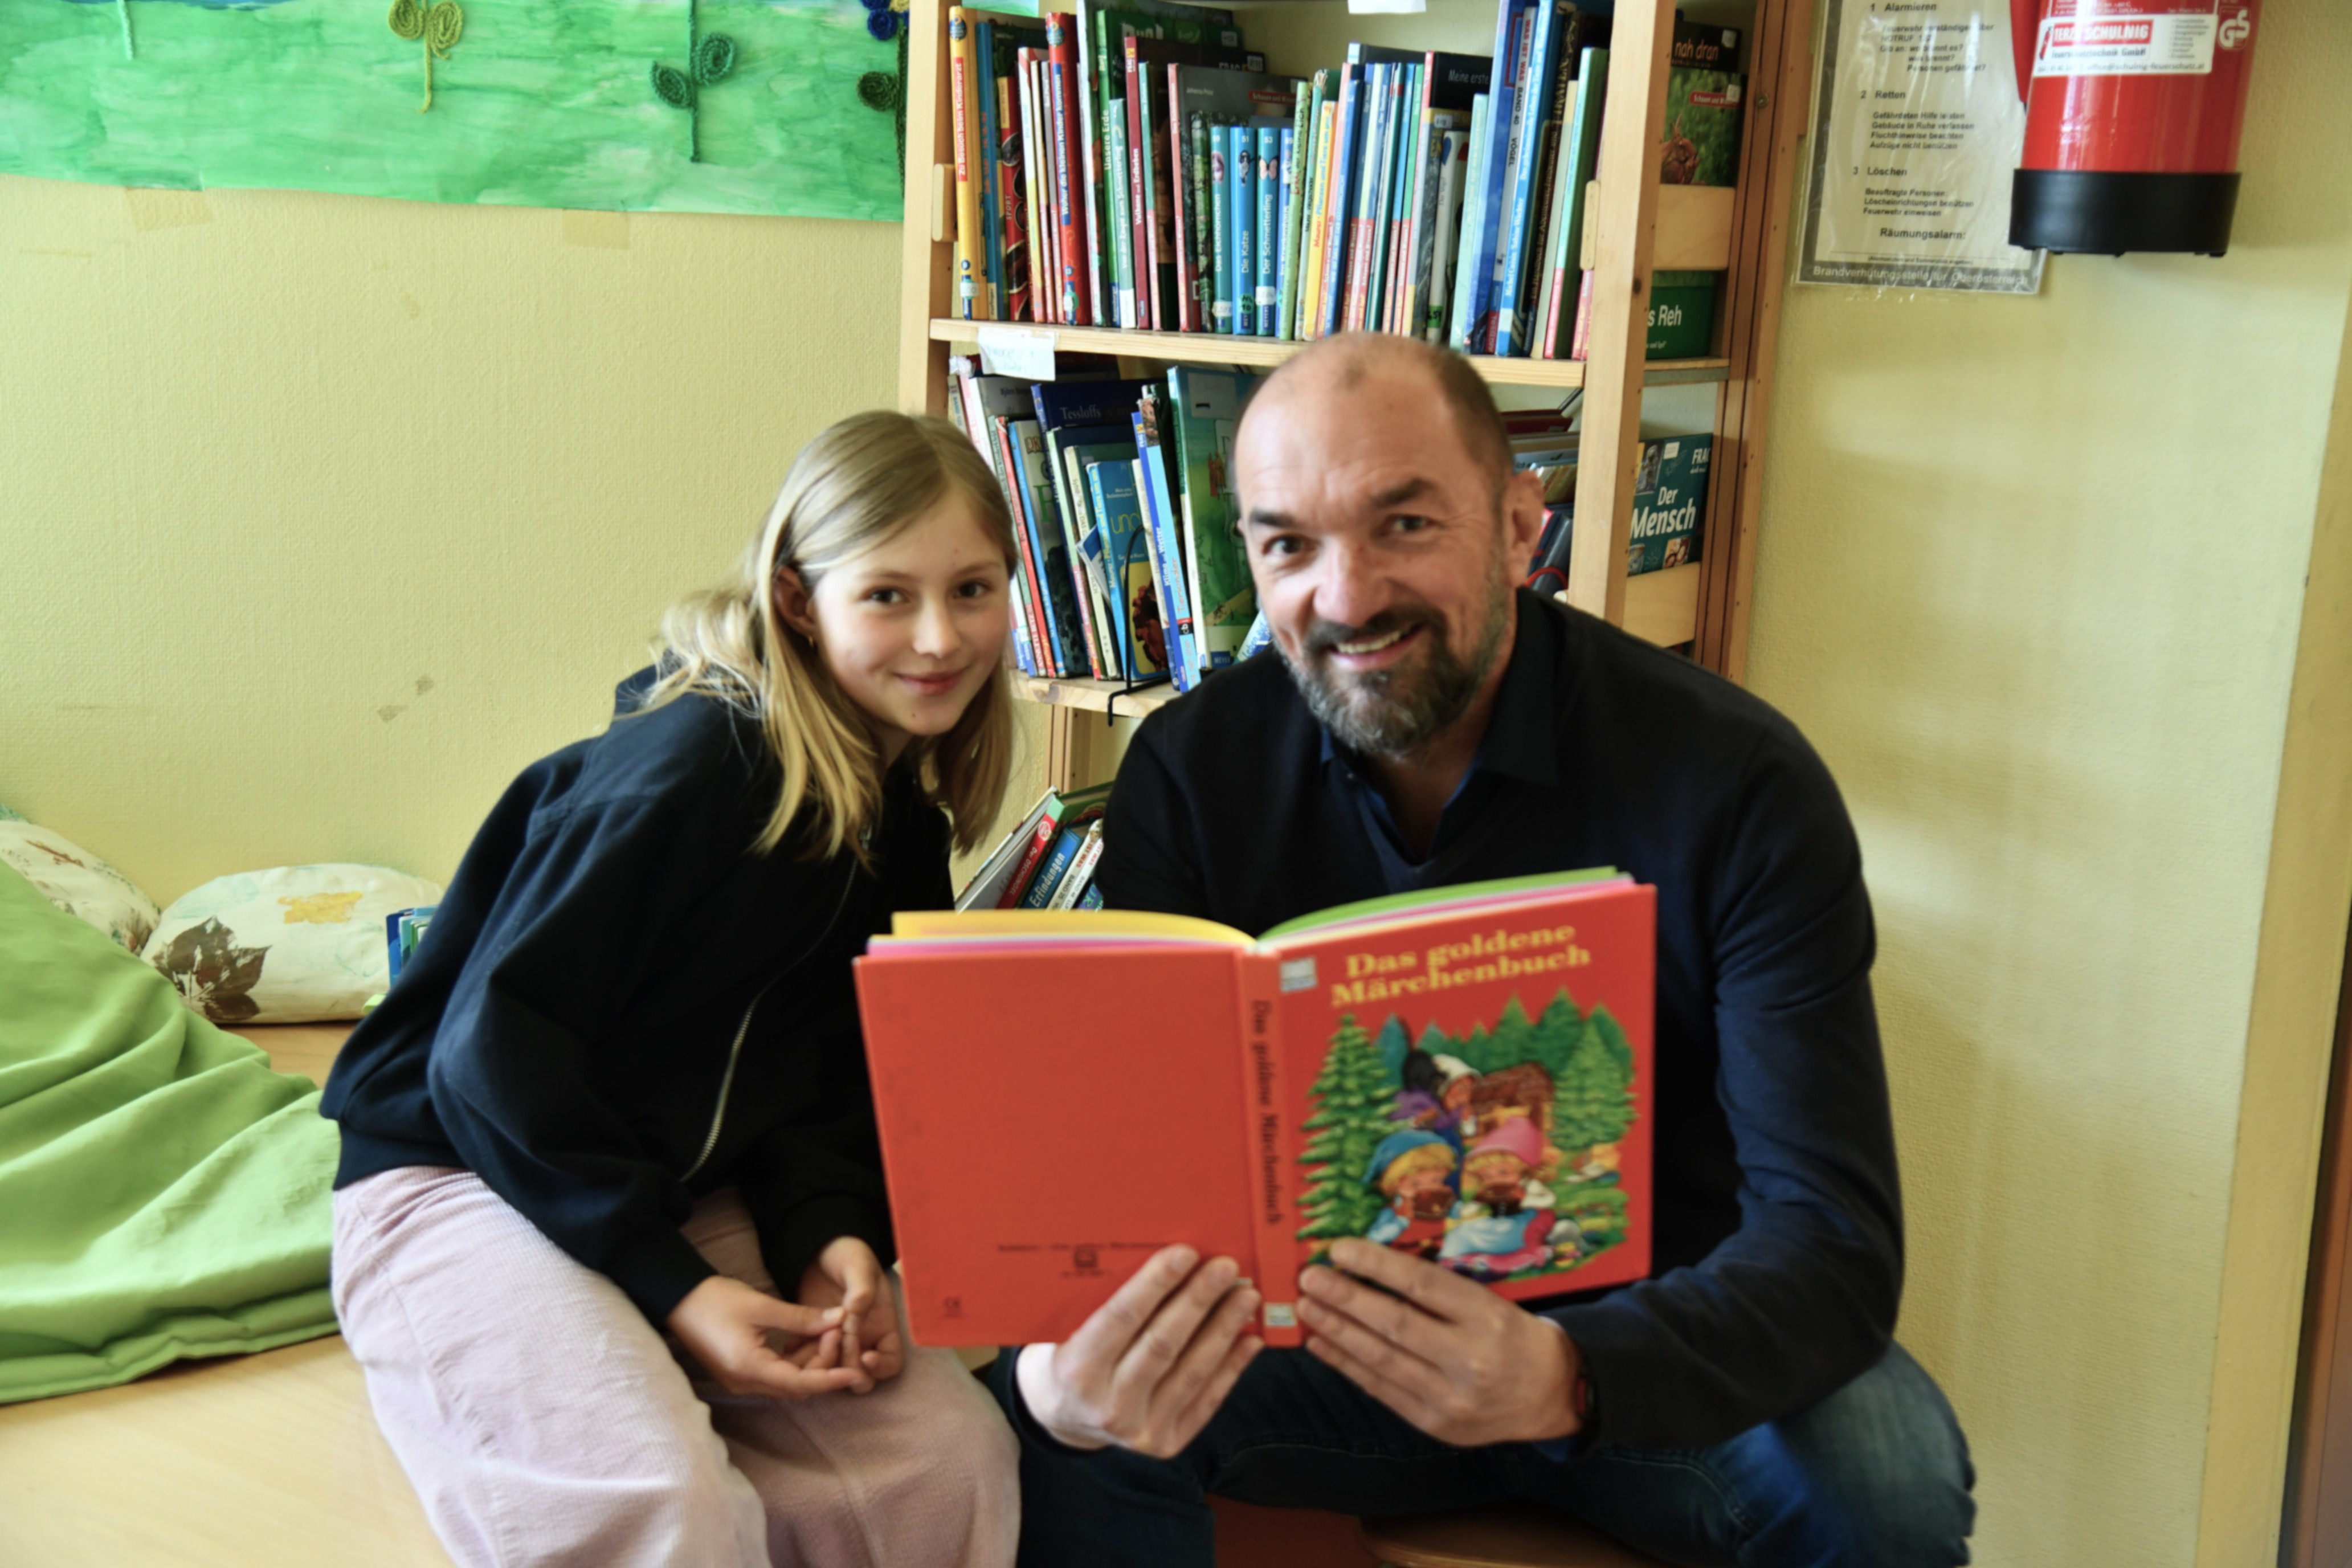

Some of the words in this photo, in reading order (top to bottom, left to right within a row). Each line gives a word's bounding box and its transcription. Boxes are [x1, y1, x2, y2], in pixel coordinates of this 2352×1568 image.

[1884, 3, 1937, 11] Alarmieren
[2085, 24, 2149, 40] SCHULNIG
[1675, 38, 1694, 59] nah
[1695, 39, 1719, 61] dran
[954, 63, 963, 109] Kinderarzt
[1470, 74, 1489, 85] erste
[1055, 74, 1063, 111] kommen
[1514, 87, 1524, 112] BAND
[1693, 94, 1711, 103] Schauen
[956, 110, 964, 132] beim
[1056, 111, 1065, 141] Kinder
[1100, 109, 1110, 132] Erde
[1295, 107, 1305, 128] Elch
[1513, 114, 1520, 125] 40
[957, 132, 966, 164] Besuch
[1324, 131, 1329, 144] um
[1058, 142, 1067, 173] kleinen
[1102, 134, 1112, 170] Unsere
[1320, 145, 1328, 164] Tiere
[1508, 137, 1518, 168] VÖGEL
[958, 164, 966, 175] Zu
[1114, 145, 1124, 199] Schmetterling
[1867, 166, 1907, 176] Löschen
[1316, 182, 1325, 215] Pflanzen
[1864, 198, 1937, 207] Löscheinrichtungen
[1865, 188, 1908, 197] Beauftragte
[1512, 197, 1524, 227] Wächter
[1118, 218, 1127, 239] Raupe
[1263, 194, 1273, 256] Schmetterling
[1313, 220, 1322, 247] Maurer
[1880, 228, 1966, 240] Räumungsalarm:
[1510, 227, 1521, 250] Sabine
[1504, 276, 1514, 297] Michel
[1657, 305, 1682, 326] Reh
[1060, 405, 1101, 420] Tessloffs
[1657, 486, 1679, 506] Der
[1631, 497, 1697, 539] Mensch
[1101, 528, 1110, 559] Pflanzen
[1155, 525, 1165, 553] Wetter
[1107, 562, 1116, 588] Maurer
[1162, 562, 1170, 586] Klima
[1171, 556, 1185, 614] Tierkinder
[1028, 613, 1037, 632] BETZ
[1028, 846, 1039, 859] Der
[1084, 843, 1093, 853] IST
[1076, 852, 1087, 868] WAS
[1008, 858, 1032, 896] DSCHUNGEL
[1029, 852, 1066, 908] Erfindungen
[1062, 873, 1075, 892] BAND
[1073, 875, 1085, 891] BAND
[1344, 951, 1418, 979] Das
[1426, 925, 1577, 967] goldene
[1330, 943, 1592, 1008] Märchenbuch
[1252, 999, 1272, 1035] Das
[1252, 1041, 1275, 1106] goldene
[1261, 1111, 1284, 1226] Märchenbuch
